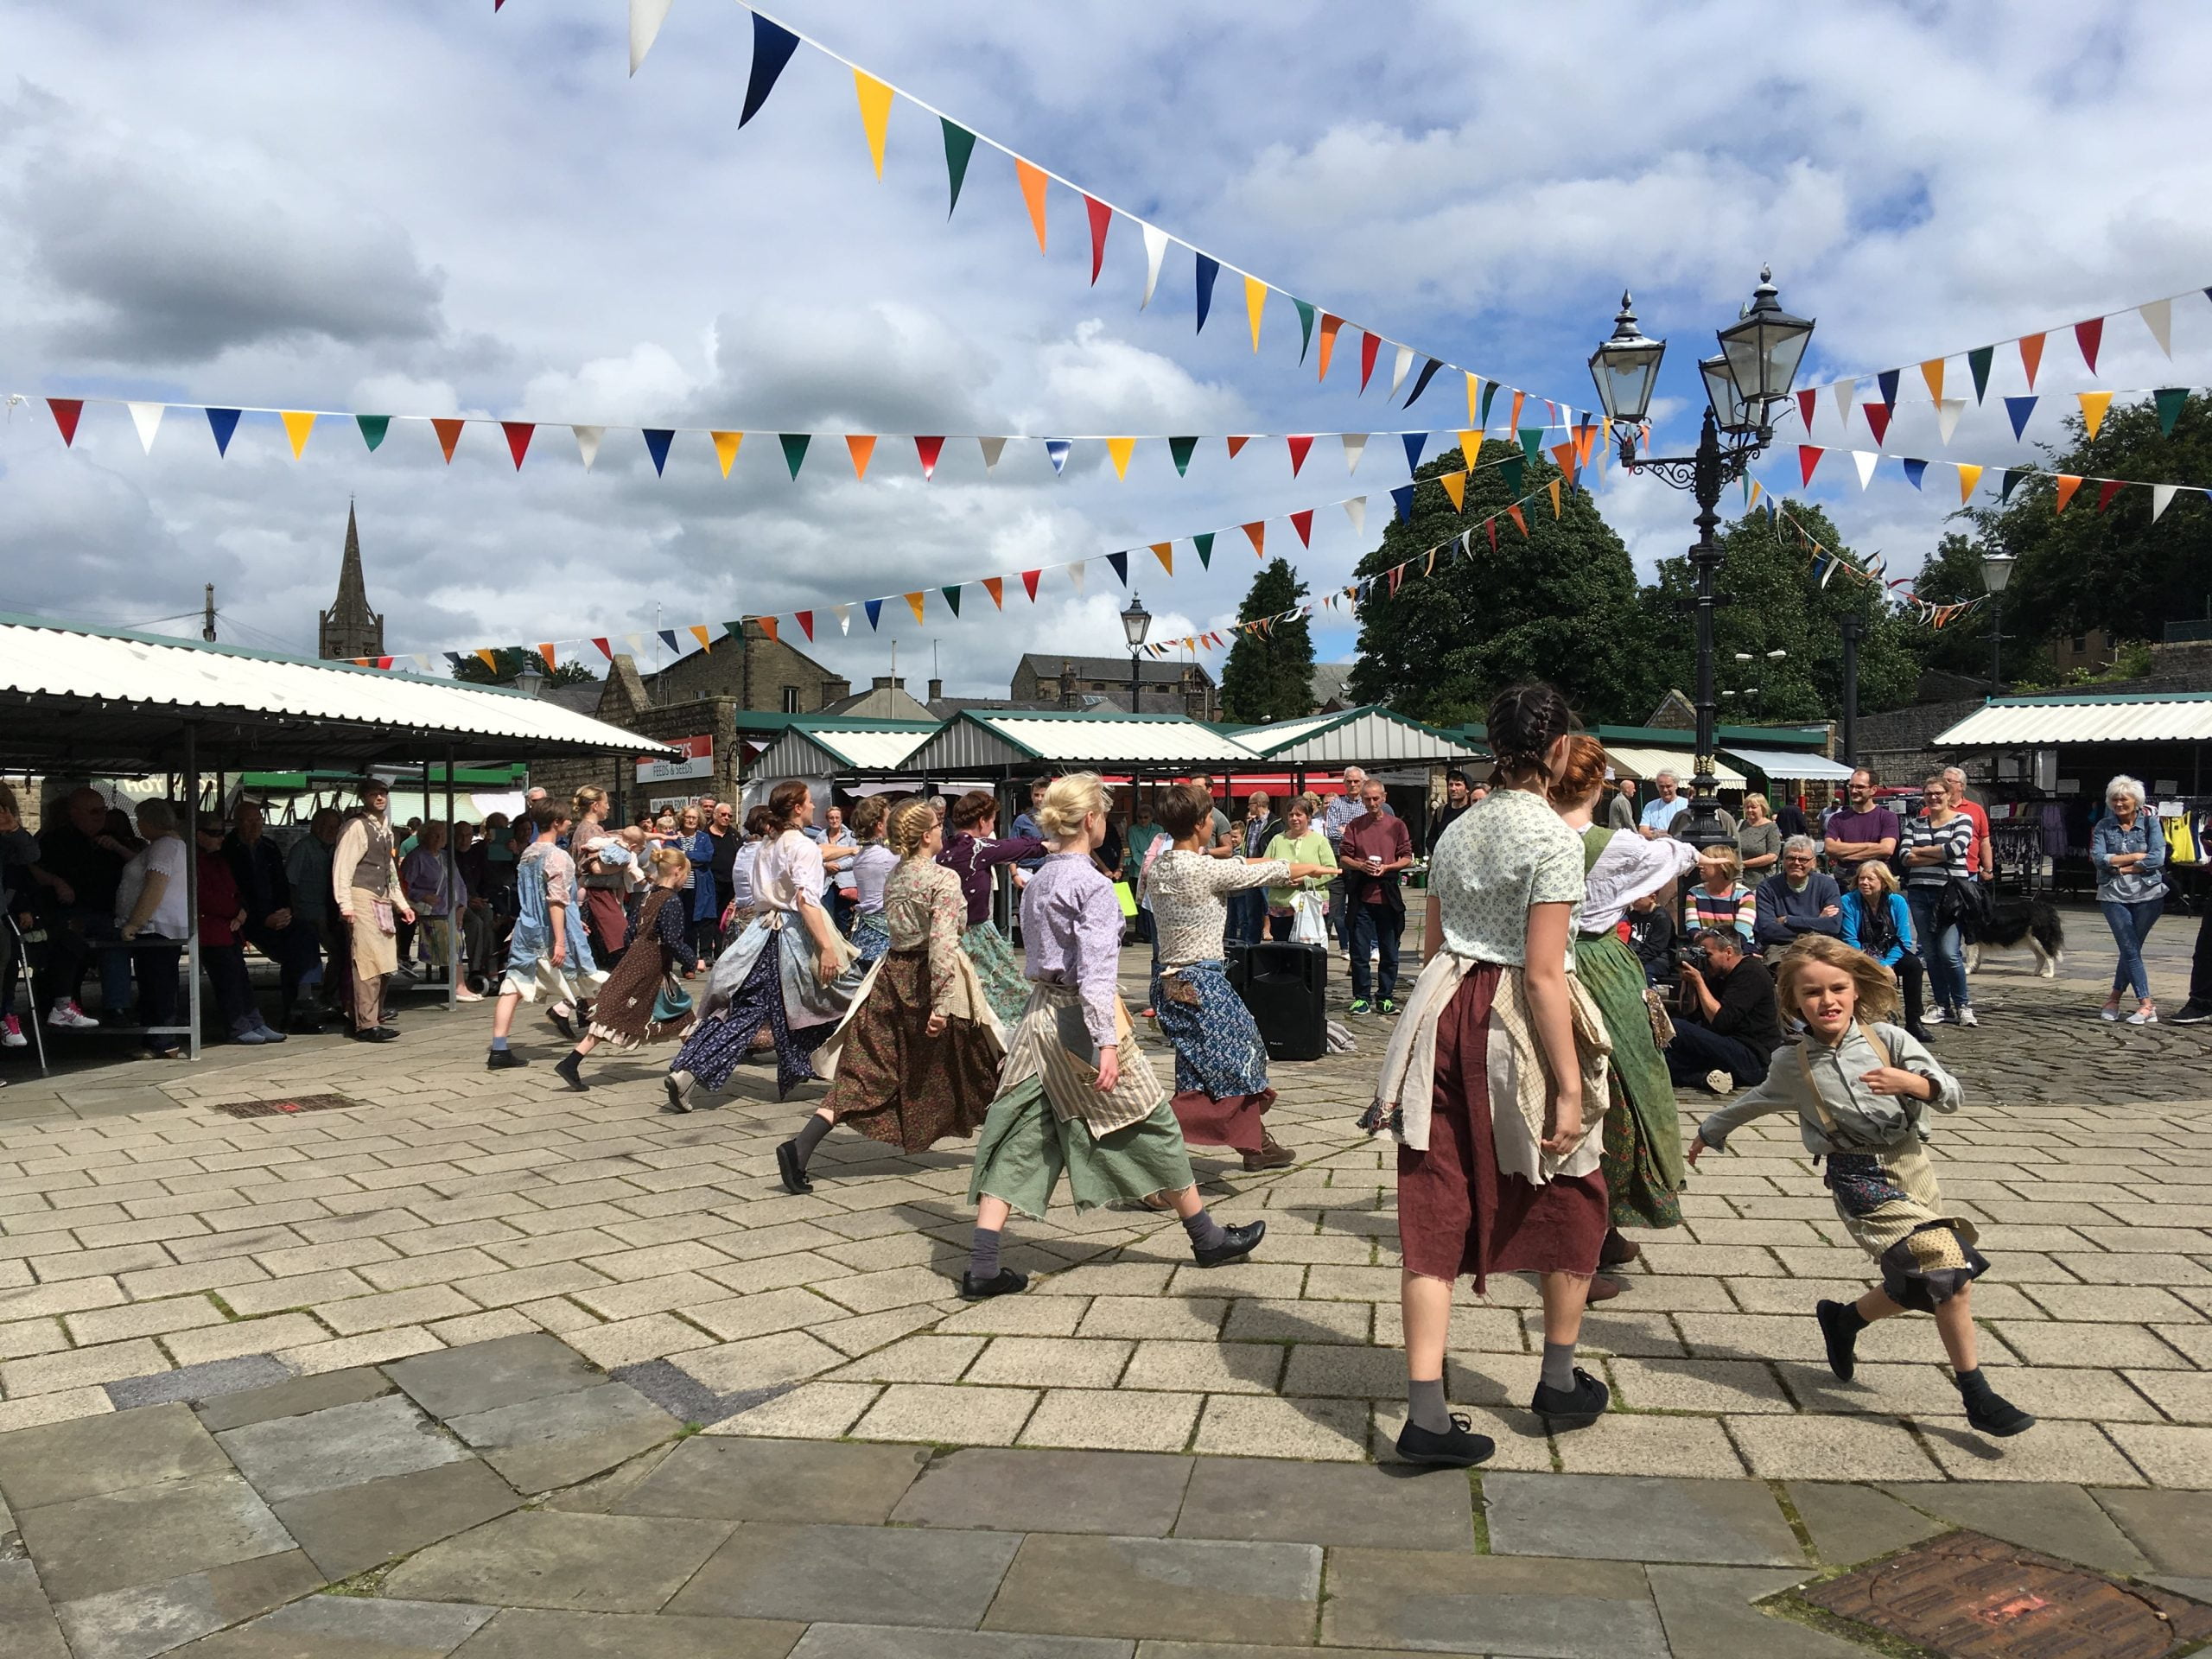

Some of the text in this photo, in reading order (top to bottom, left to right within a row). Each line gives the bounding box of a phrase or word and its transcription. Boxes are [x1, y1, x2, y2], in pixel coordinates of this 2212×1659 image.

[653, 762, 693, 777] FEEDS & SEEDS
